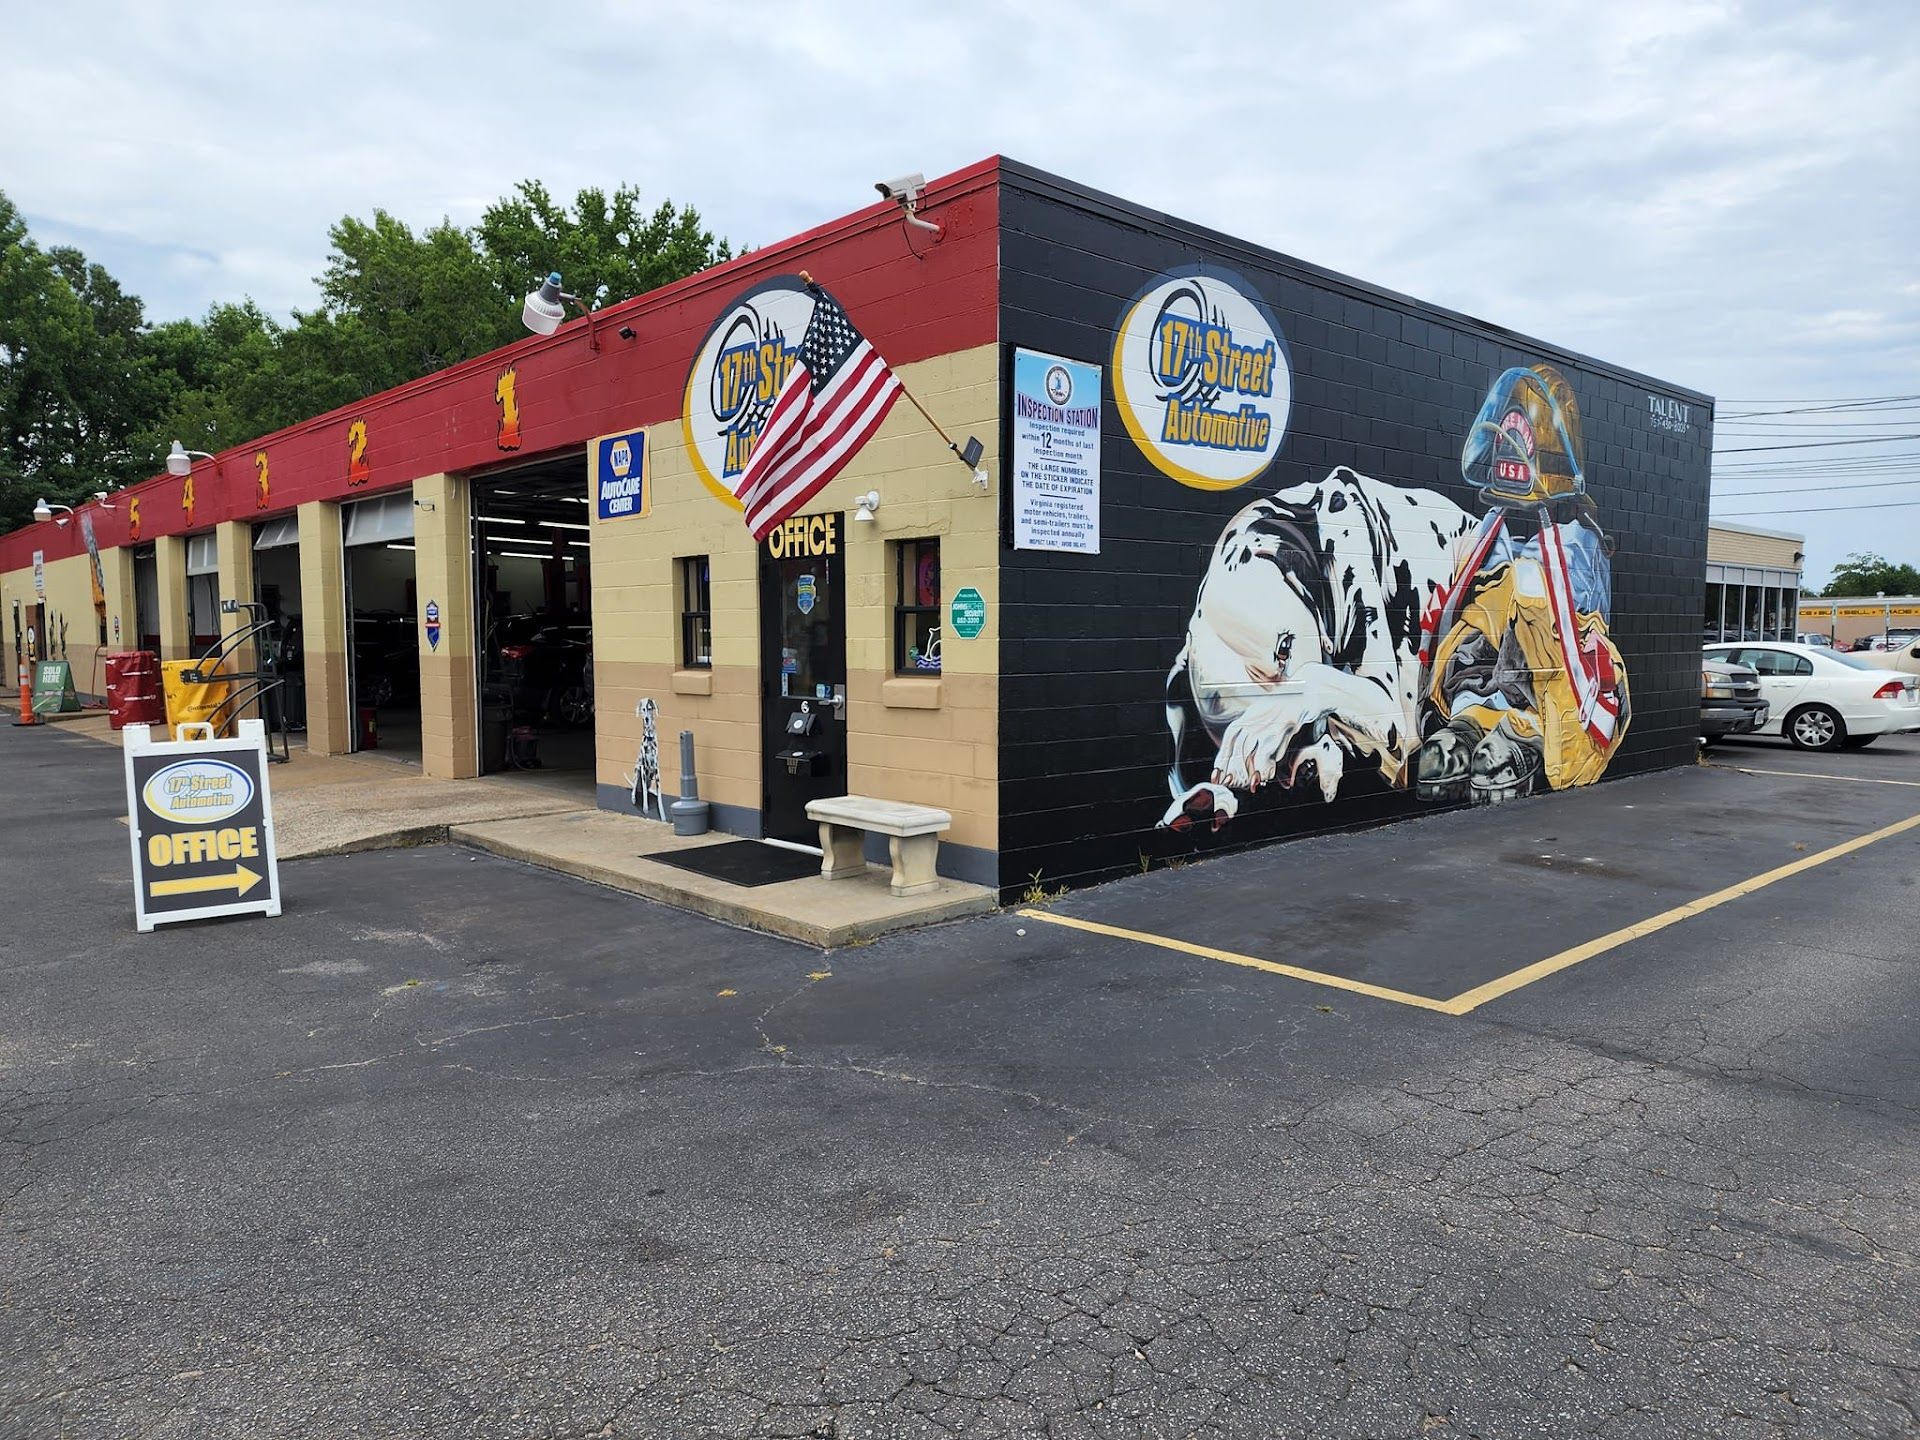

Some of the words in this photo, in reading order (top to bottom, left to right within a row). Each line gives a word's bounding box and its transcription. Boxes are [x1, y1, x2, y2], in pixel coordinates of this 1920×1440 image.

[1203, 329, 1274, 394] Street
[495, 366, 521, 452] 1
[1017, 393, 1064, 423] INSPECTION
[1066, 407, 1098, 429] STATION
[1648, 395, 1689, 422] TALENT
[1029, 421, 1060, 433] Inspection
[1061, 427, 1085, 437] required
[1164, 398, 1269, 448] Automotive
[1022, 433, 1040, 441] within
[1041, 431, 1052, 449] 12
[1053, 438, 1074, 447] months
[1083, 442, 1094, 450] last
[348, 415, 370, 487] 2
[1065, 451, 1083, 460] month
[1028, 462, 1039, 470] THE
[1040, 464, 1059, 472] LARGE
[1061, 466, 1088, 476] NUMBERS
[1500, 462, 1524, 480] USA
[255, 448, 271, 510] 3
[1022, 480, 1033, 488] THE
[1035, 482, 1050, 490] DATE
[1060, 485, 1093, 495] EXPIRATION
[1031, 472, 1042, 480] THE
[1043, 474, 1068, 483] STICKER
[1070, 477, 1094, 487] INDICATE
[182, 472, 195, 527] 4
[609, 497, 633, 514] CENTER
[1030, 499, 1053, 508] Virginia
[1054, 503, 1084, 511] registered
[129, 496, 141, 541] 5
[1024, 508, 1041, 516] motor
[768, 513, 836, 559] OFFICE
[1061, 530, 1085, 540] annually
[42, 673, 60, 684] HERE
[43, 665, 61, 675] SOLD
[190, 772, 232, 791] Street
[170, 793, 233, 810] Automotive
[147, 826, 259, 868] OFFICE
